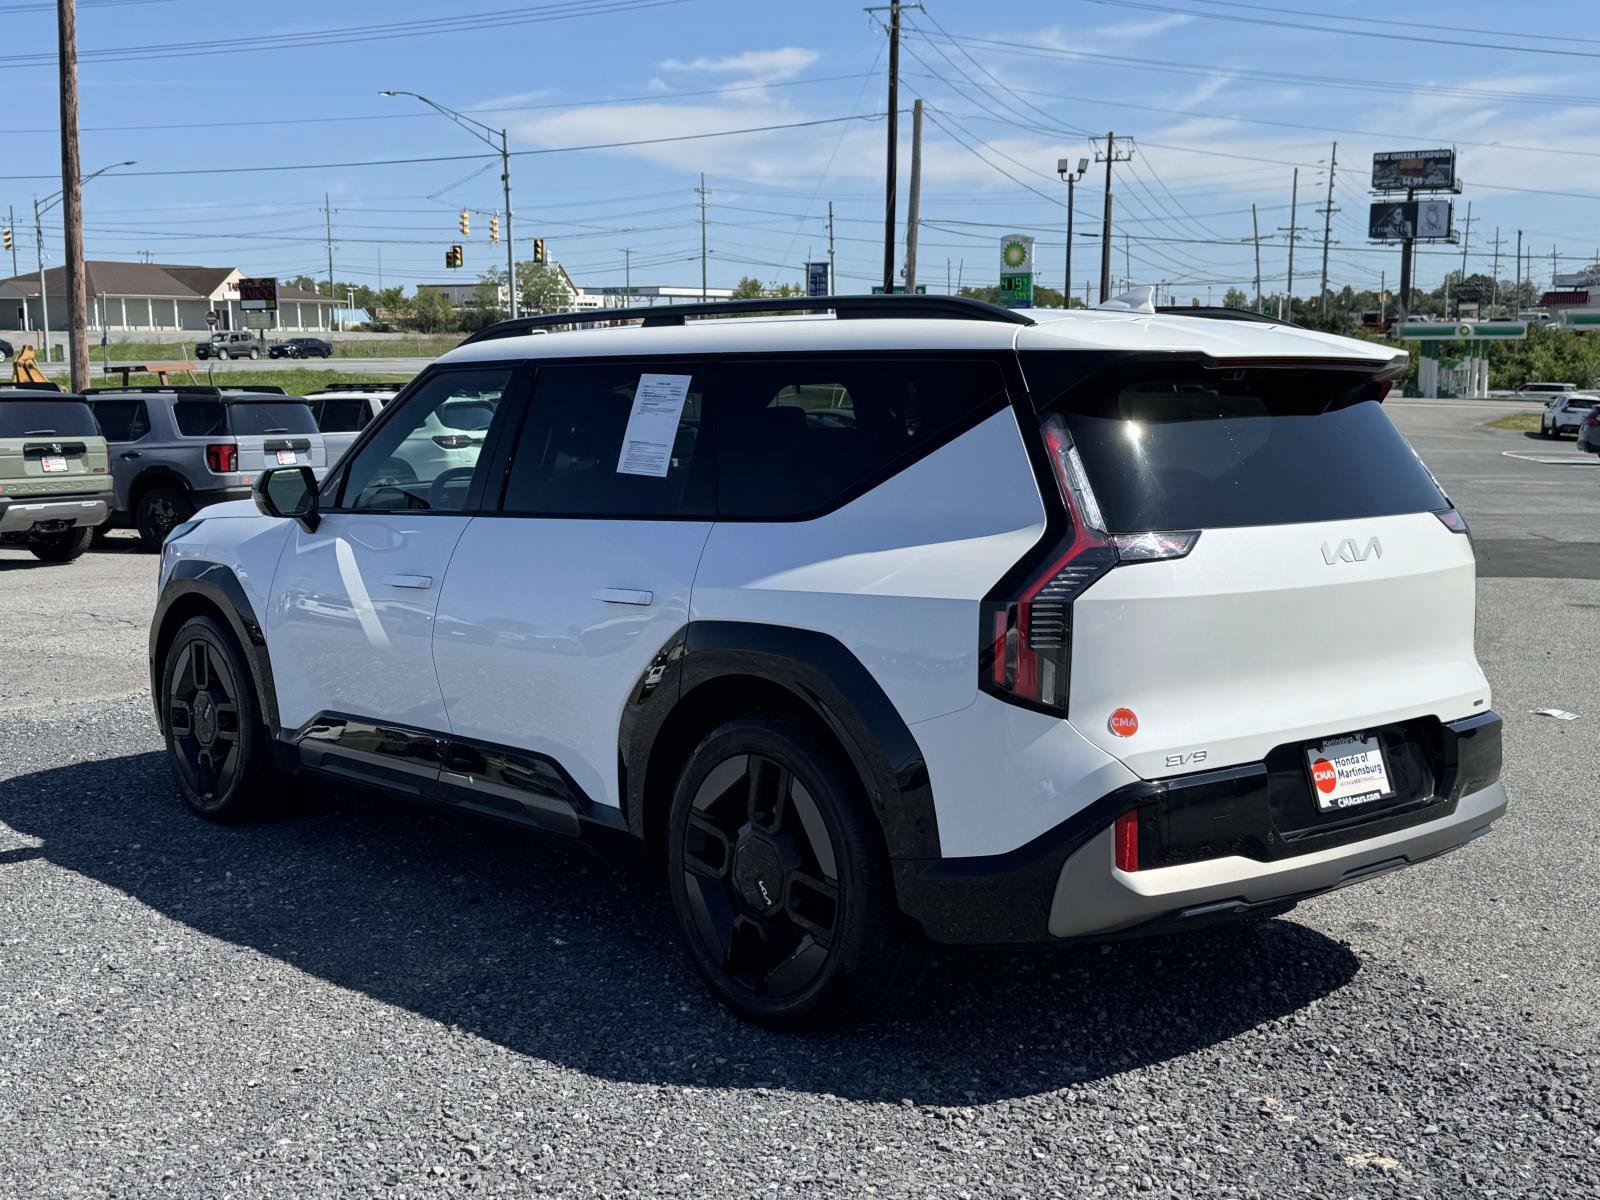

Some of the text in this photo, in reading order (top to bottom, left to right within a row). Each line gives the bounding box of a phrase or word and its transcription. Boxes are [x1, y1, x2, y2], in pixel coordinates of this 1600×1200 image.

[1417, 151, 1450, 159] SANDWICH
[6, 480, 105, 493] PASSPORT
[1320, 536, 1383, 566] KIA
[1111, 717, 1136, 727] CMA
[1166, 750, 1207, 767] EV9
[1334, 752, 1369, 768] Honda of
[1337, 764, 1382, 778] Martinsburg
[1337, 792, 1381, 807] CMAcars.com
